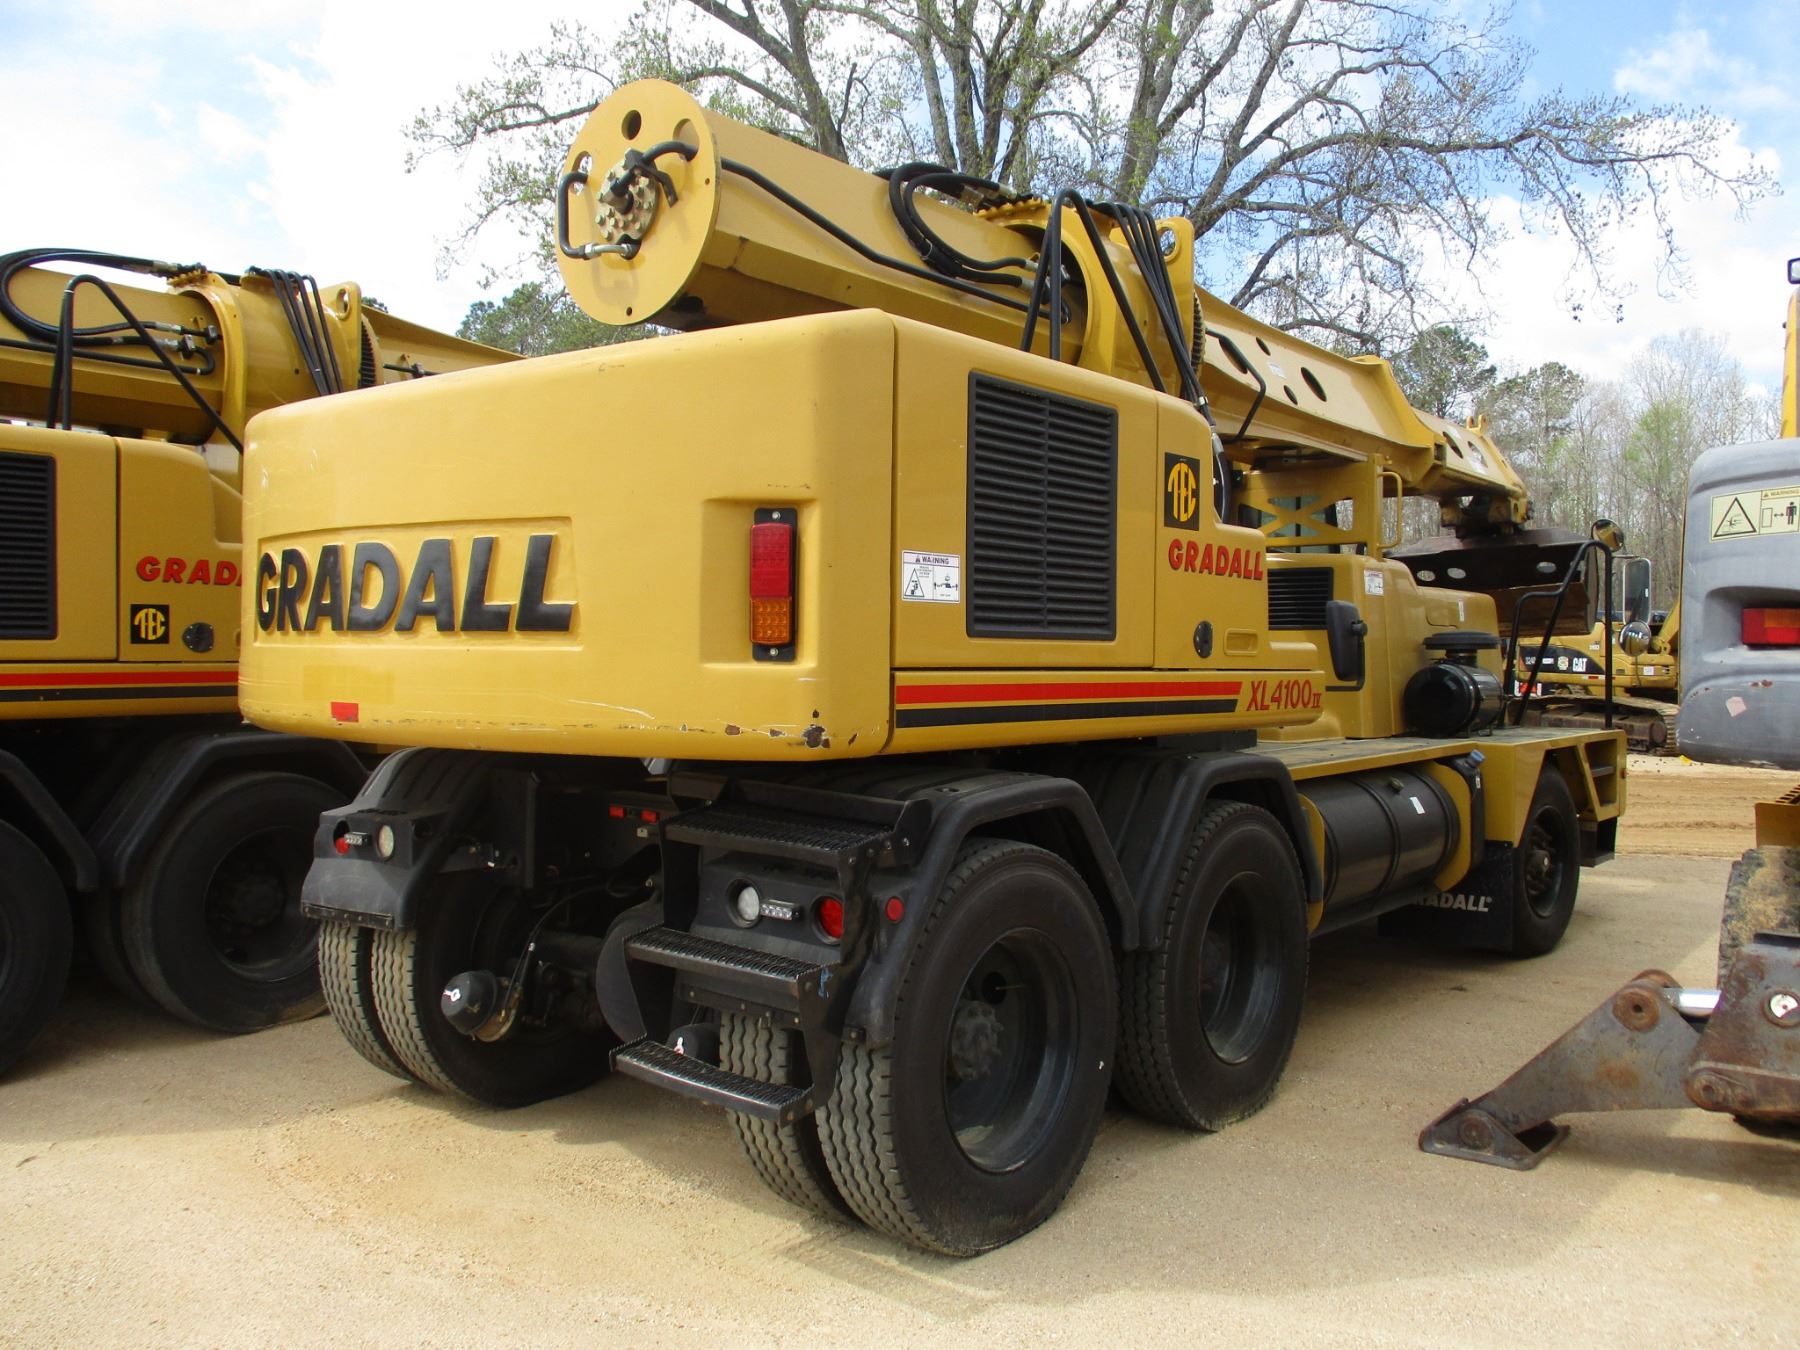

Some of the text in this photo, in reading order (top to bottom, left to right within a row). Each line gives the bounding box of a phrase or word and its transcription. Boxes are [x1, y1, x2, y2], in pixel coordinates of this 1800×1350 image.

[1168, 538, 1264, 581] GRADALL
[256, 534, 575, 632] GRADALL
[1572, 657, 1588, 672] CAT
[1246, 679, 1312, 712] XL4100
